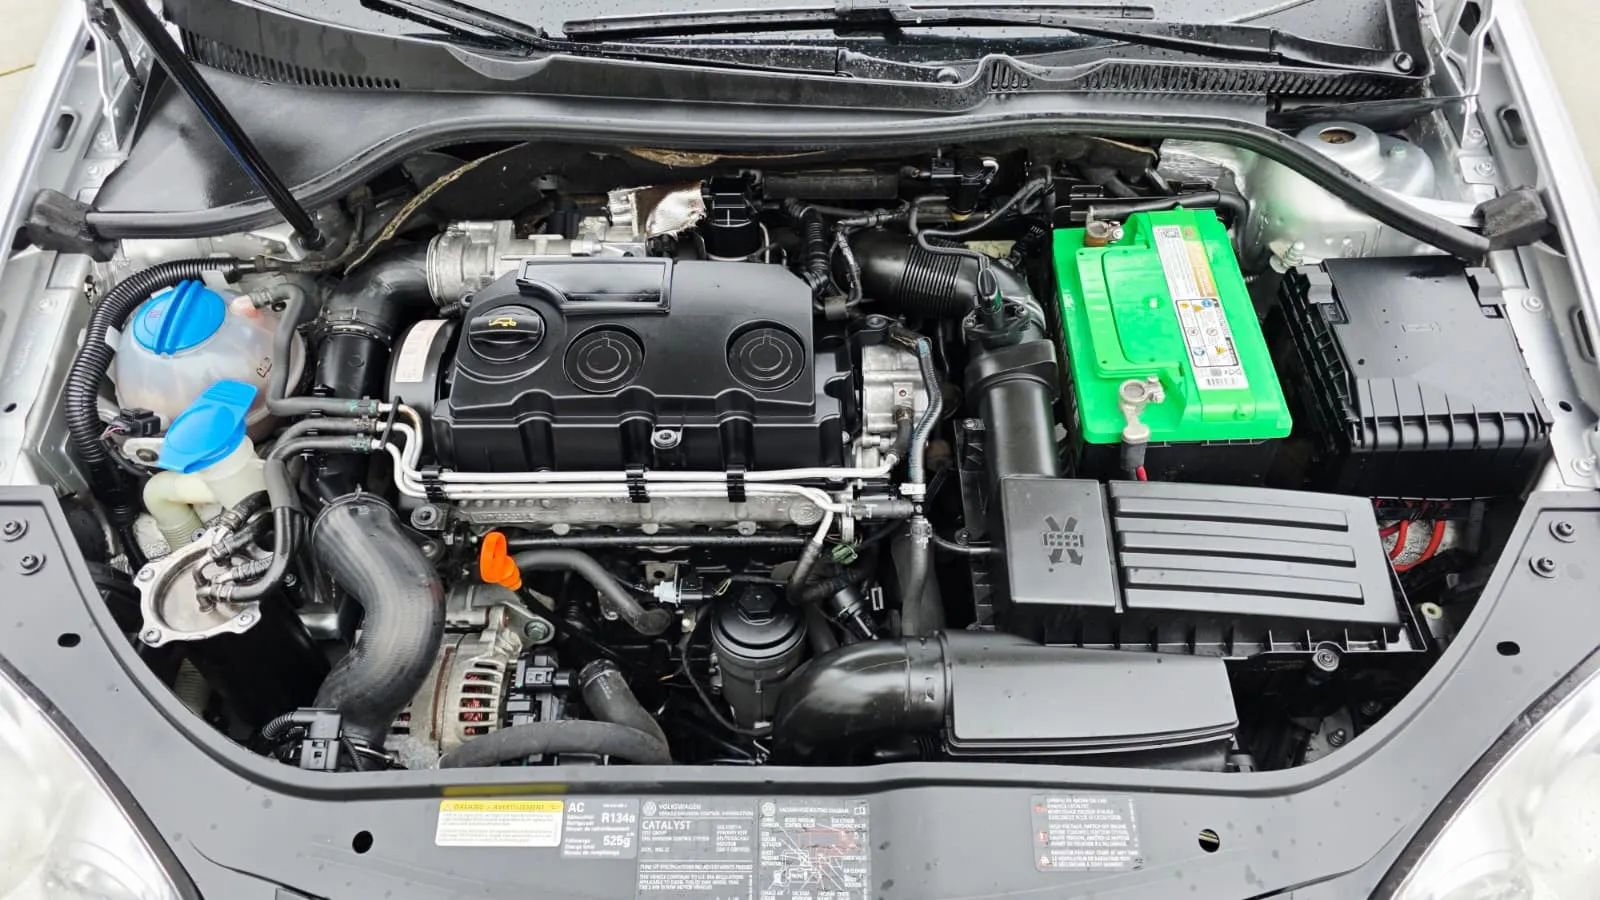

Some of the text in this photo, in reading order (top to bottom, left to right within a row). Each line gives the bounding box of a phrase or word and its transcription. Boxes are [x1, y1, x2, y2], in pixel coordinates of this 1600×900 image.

[567, 802, 585, 813] AC
[658, 802, 702, 810] VOLKSWAGEN
[601, 812, 636, 824] R134a
[642, 820, 692, 831] CATALYST
[603, 834, 632, 848] 525g
